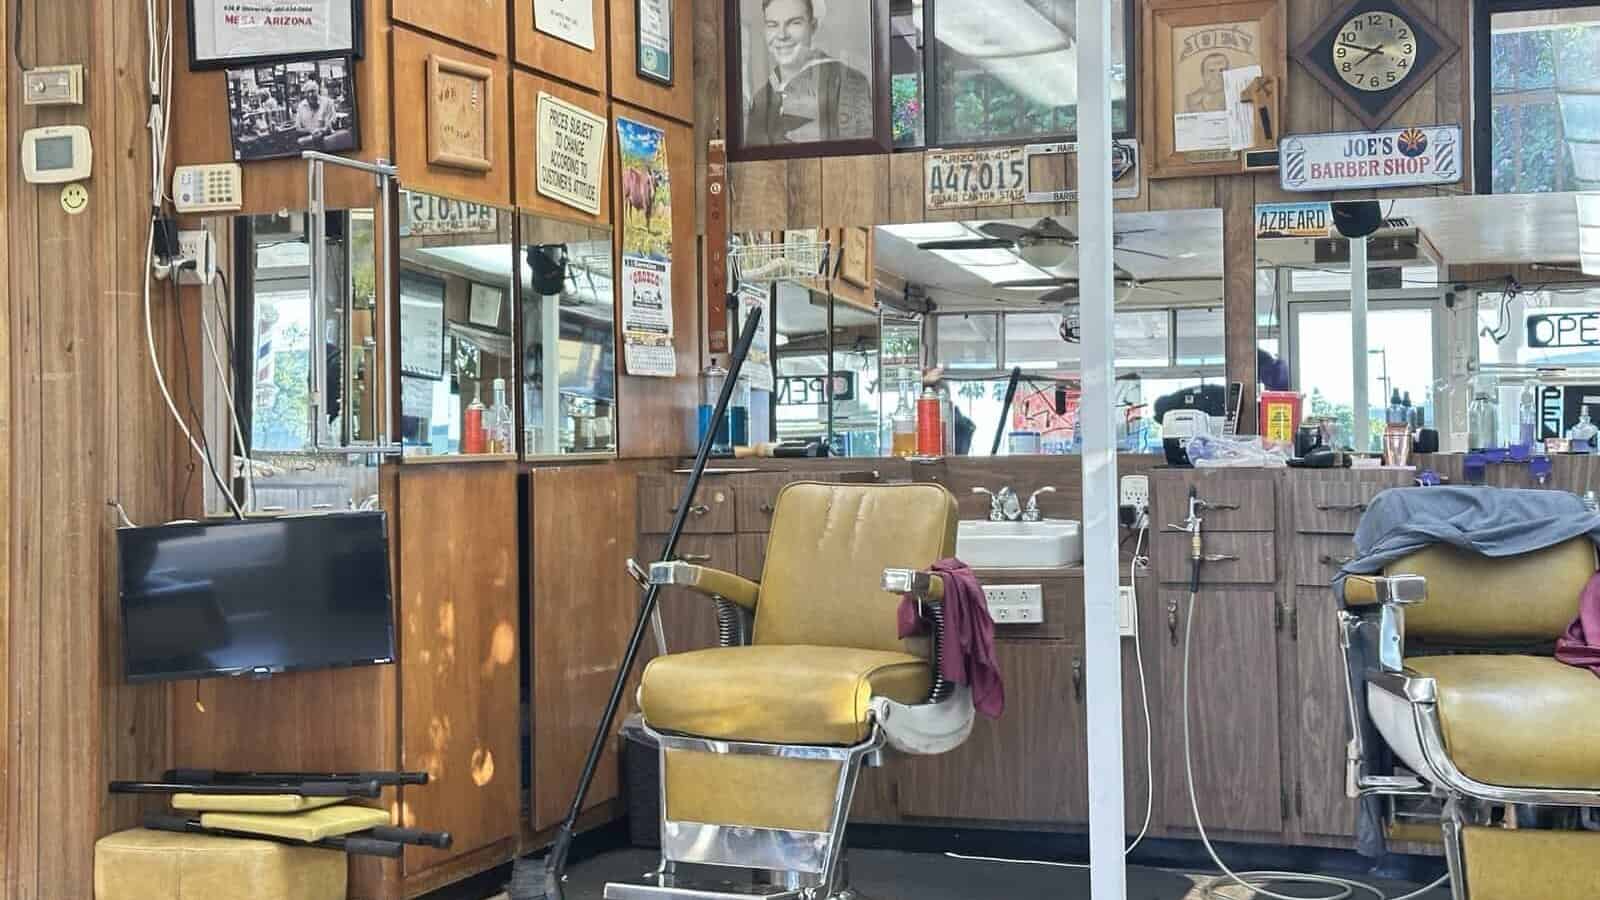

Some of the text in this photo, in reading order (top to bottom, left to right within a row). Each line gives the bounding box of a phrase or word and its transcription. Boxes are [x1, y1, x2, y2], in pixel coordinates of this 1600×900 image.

[264, 15, 312, 25] ARIZONA
[1354, 20, 1363, 31] 11
[1368, 15, 1382, 25] 12
[1389, 18, 1393, 28] 1
[1341, 32, 1356, 42] 10
[1398, 28, 1408, 39] 2
[1337, 47, 1346, 57] 9
[1403, 43, 1412, 54] 3
[1342, 61, 1352, 72] 8
[1397, 58, 1407, 69] 4
[1354, 73, 1364, 83] 7
[1370, 76, 1379, 87] 6
[1386, 71, 1396, 81] 5
[549, 108, 594, 140] PRICES SUBJECT
[555, 131, 585, 157] TO CHANGE
[1057, 144, 1073, 152] HAIR
[1343, 137, 1393, 157] JOE'S
[551, 149, 588, 178] ACCORDING TO
[1311, 157, 1430, 180] BARBER SHOP
[573, 179, 596, 202] ATTITUDE
[962, 192, 996, 201] CANYON
[1000, 190, 1025, 201] STATE
[1260, 210, 1326, 230] AZBEARD
